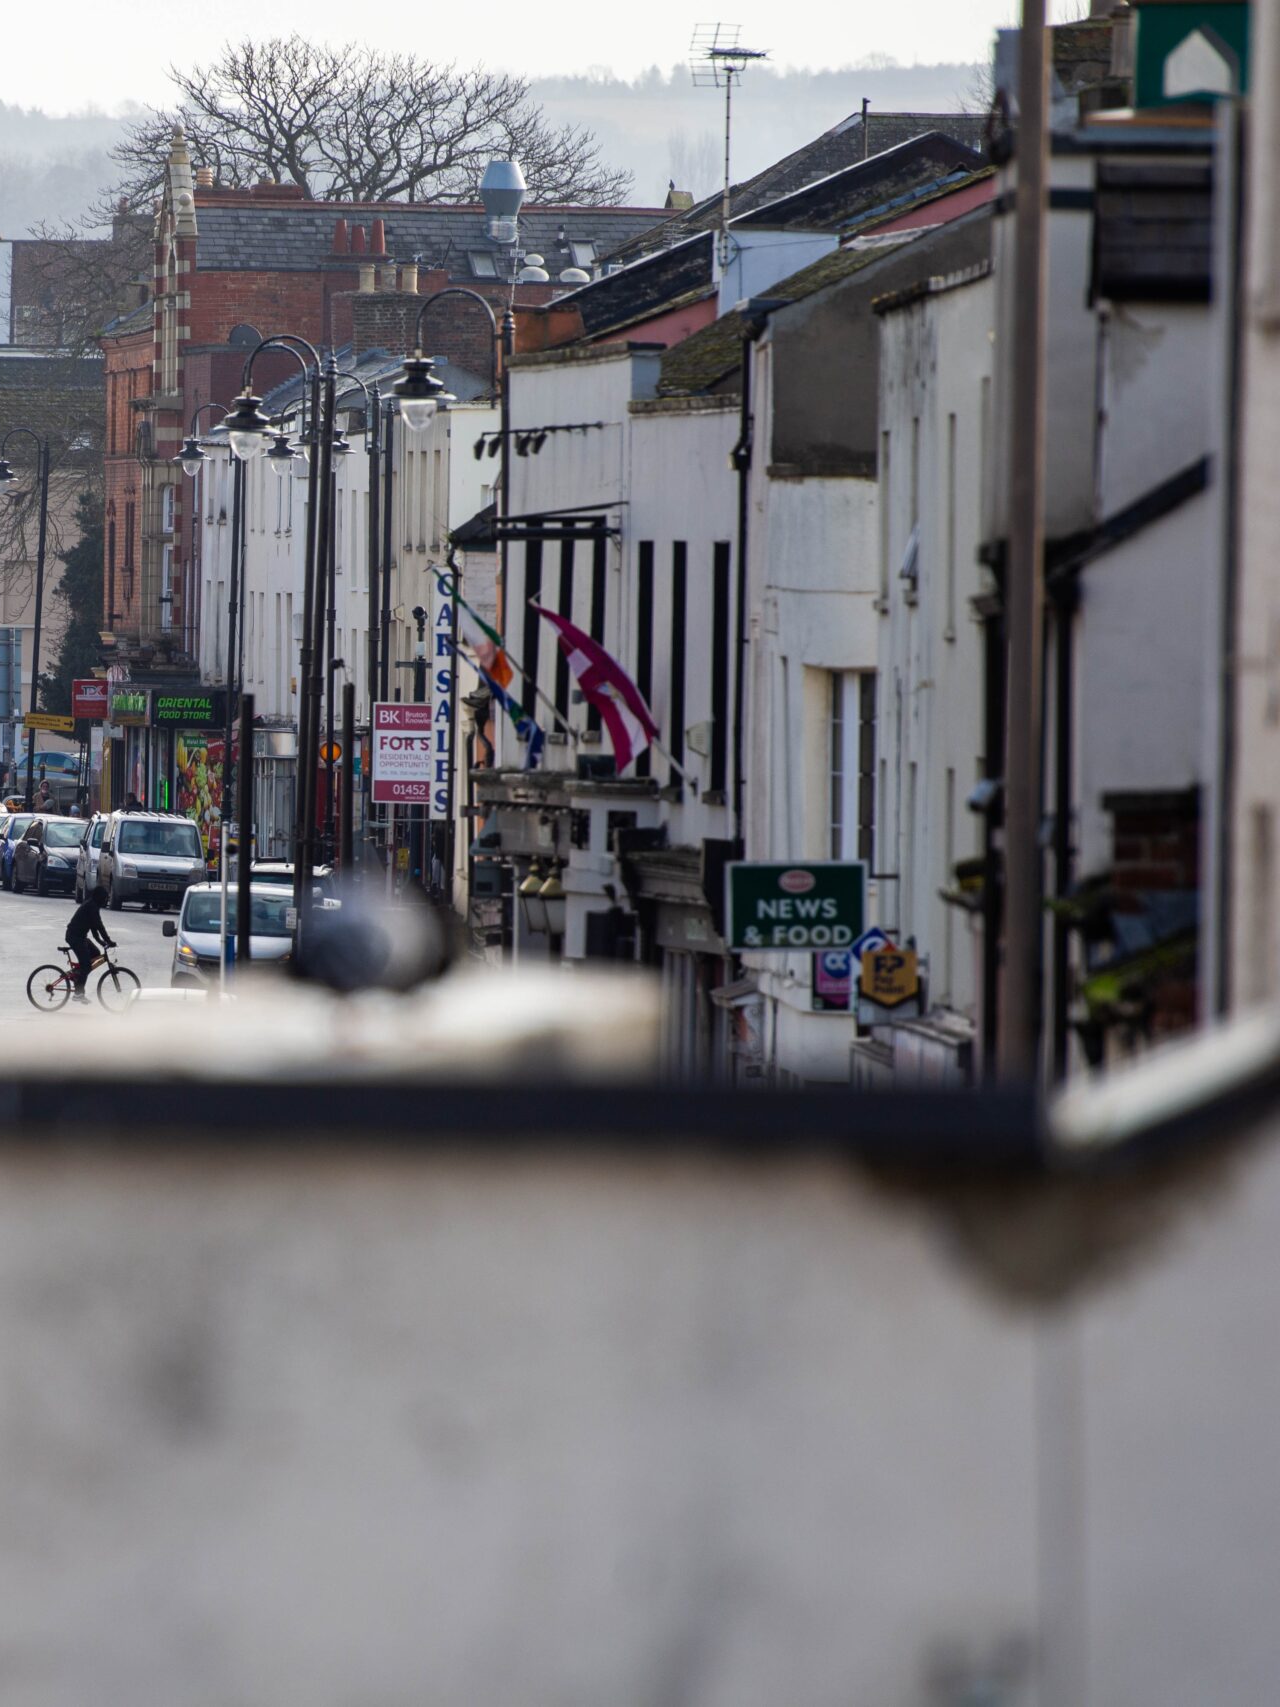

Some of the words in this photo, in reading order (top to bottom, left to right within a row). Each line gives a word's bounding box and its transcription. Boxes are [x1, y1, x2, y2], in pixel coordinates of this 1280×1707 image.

[435, 573, 453, 656] CAR
[157, 697, 213, 709] ORIENTAL
[158, 710, 181, 720] FOOD
[182, 711, 212, 720] STORE
[379, 710, 401, 724] BK
[379, 736, 415, 751] FOR
[434, 669, 452, 813] SALES
[379, 753, 423, 761] RESIDENTIAL
[379, 761, 430, 769] OPPORTUNITY
[392, 784, 426, 796] 01452
[756, 898, 838, 919] NEWS
[744, 925, 762, 946] &
[772, 924, 852, 946] FOOD
